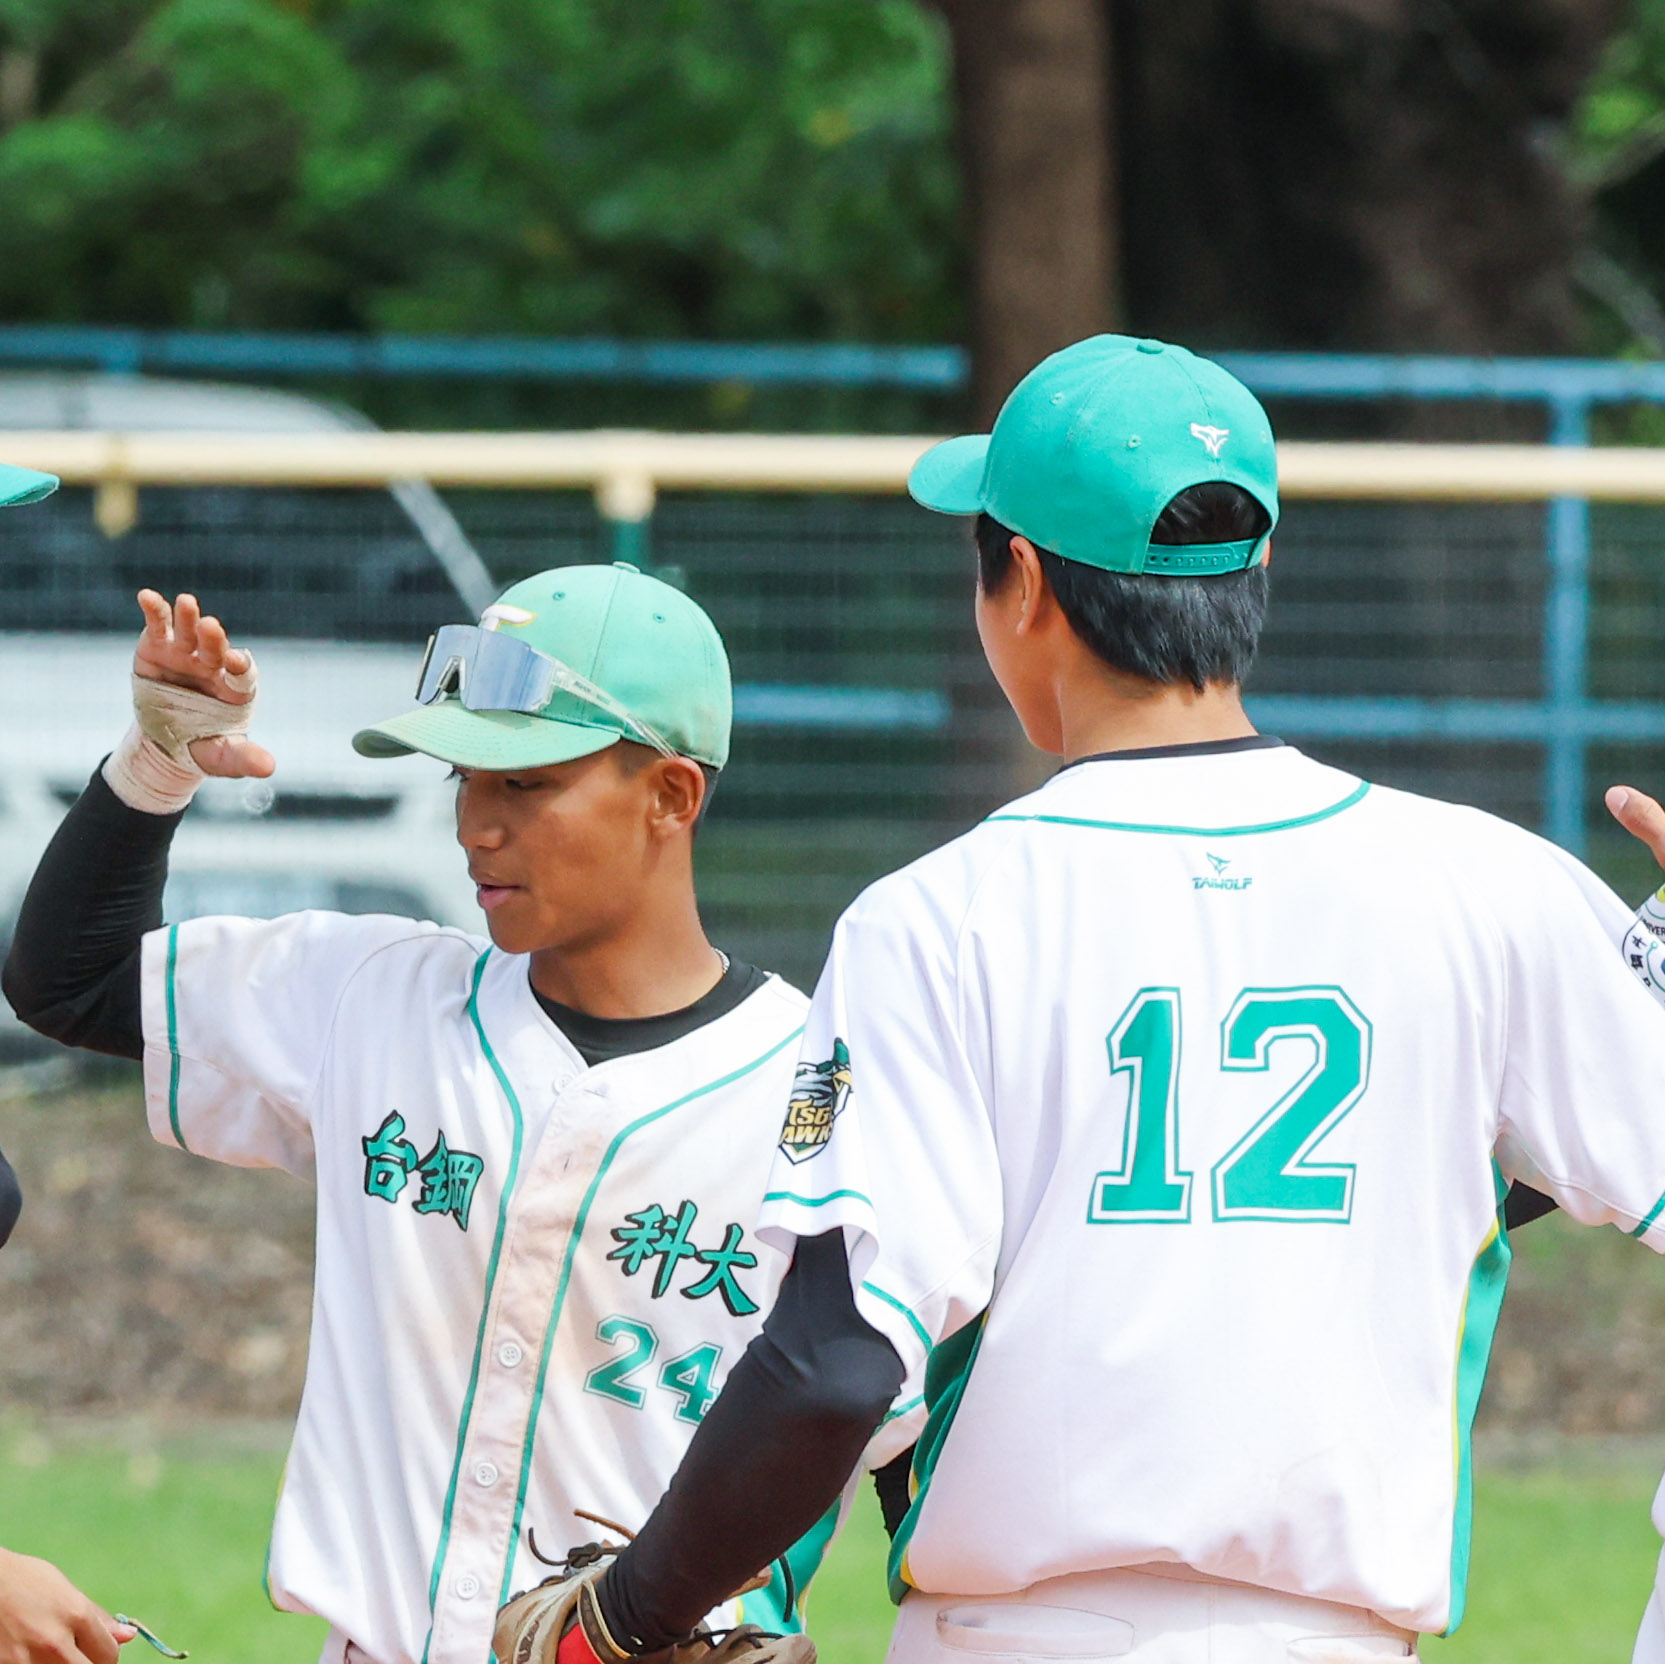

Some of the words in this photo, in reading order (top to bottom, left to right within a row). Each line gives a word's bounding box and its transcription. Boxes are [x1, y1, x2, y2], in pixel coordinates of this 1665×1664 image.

[787, 1098, 832, 1126] TSG
[1086, 985, 1373, 1225] 12
[361, 1108, 484, 1232] 台鋼
[606, 1199, 760, 1317] 科大
[583, 1313, 724, 1428] 24
